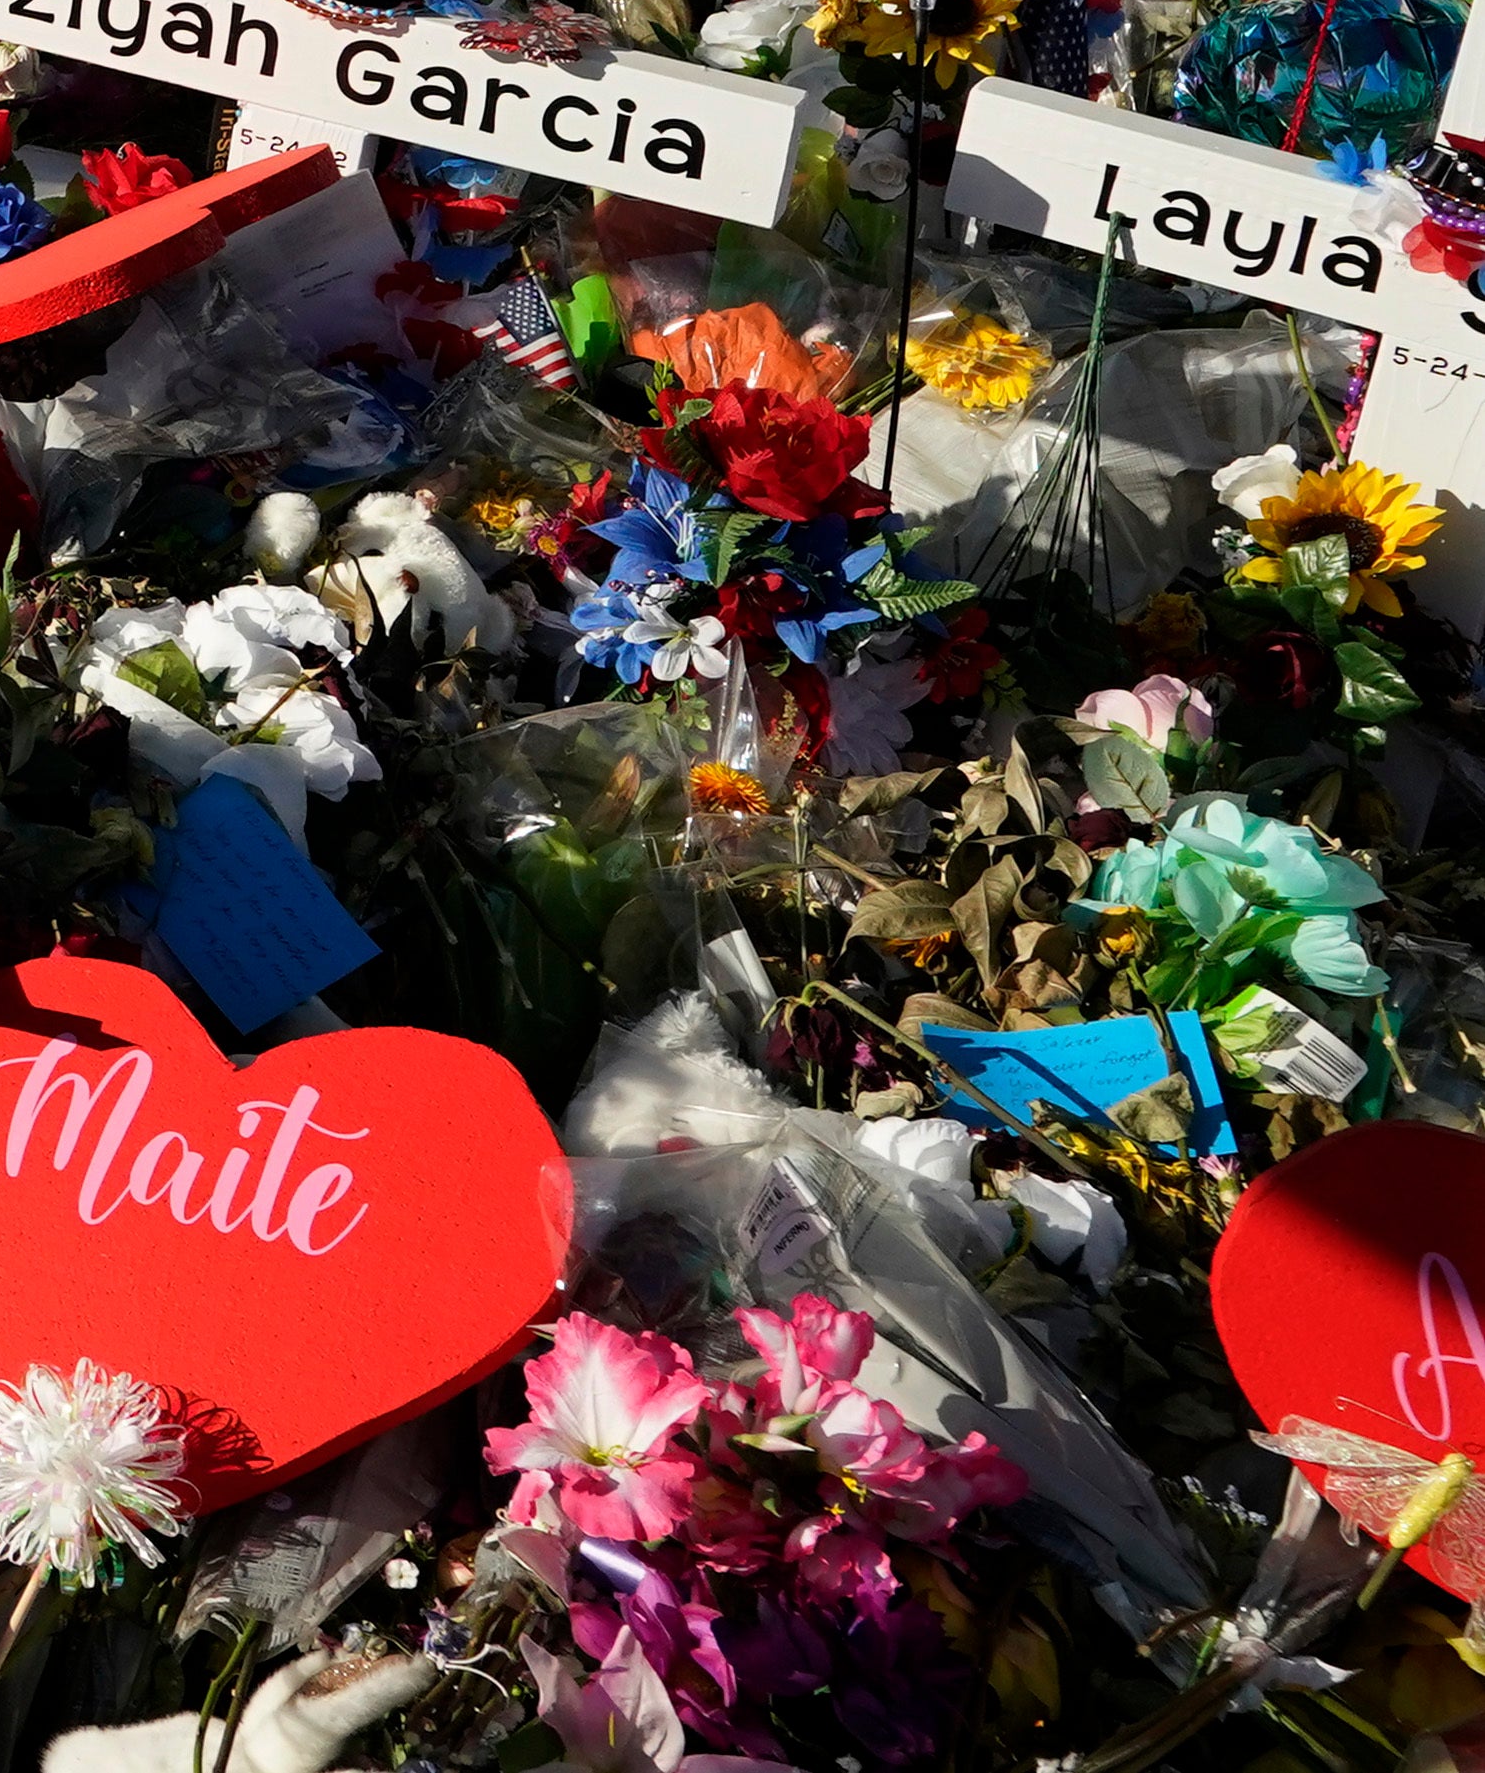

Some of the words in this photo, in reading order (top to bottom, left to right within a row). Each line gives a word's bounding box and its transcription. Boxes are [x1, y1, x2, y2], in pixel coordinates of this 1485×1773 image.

[211, 107, 236, 176] Tri-Sta
[335, 38, 707, 181] Garcia
[1093, 161, 1384, 295] Layla
[772, 1220, 810, 1256] INFERNO
